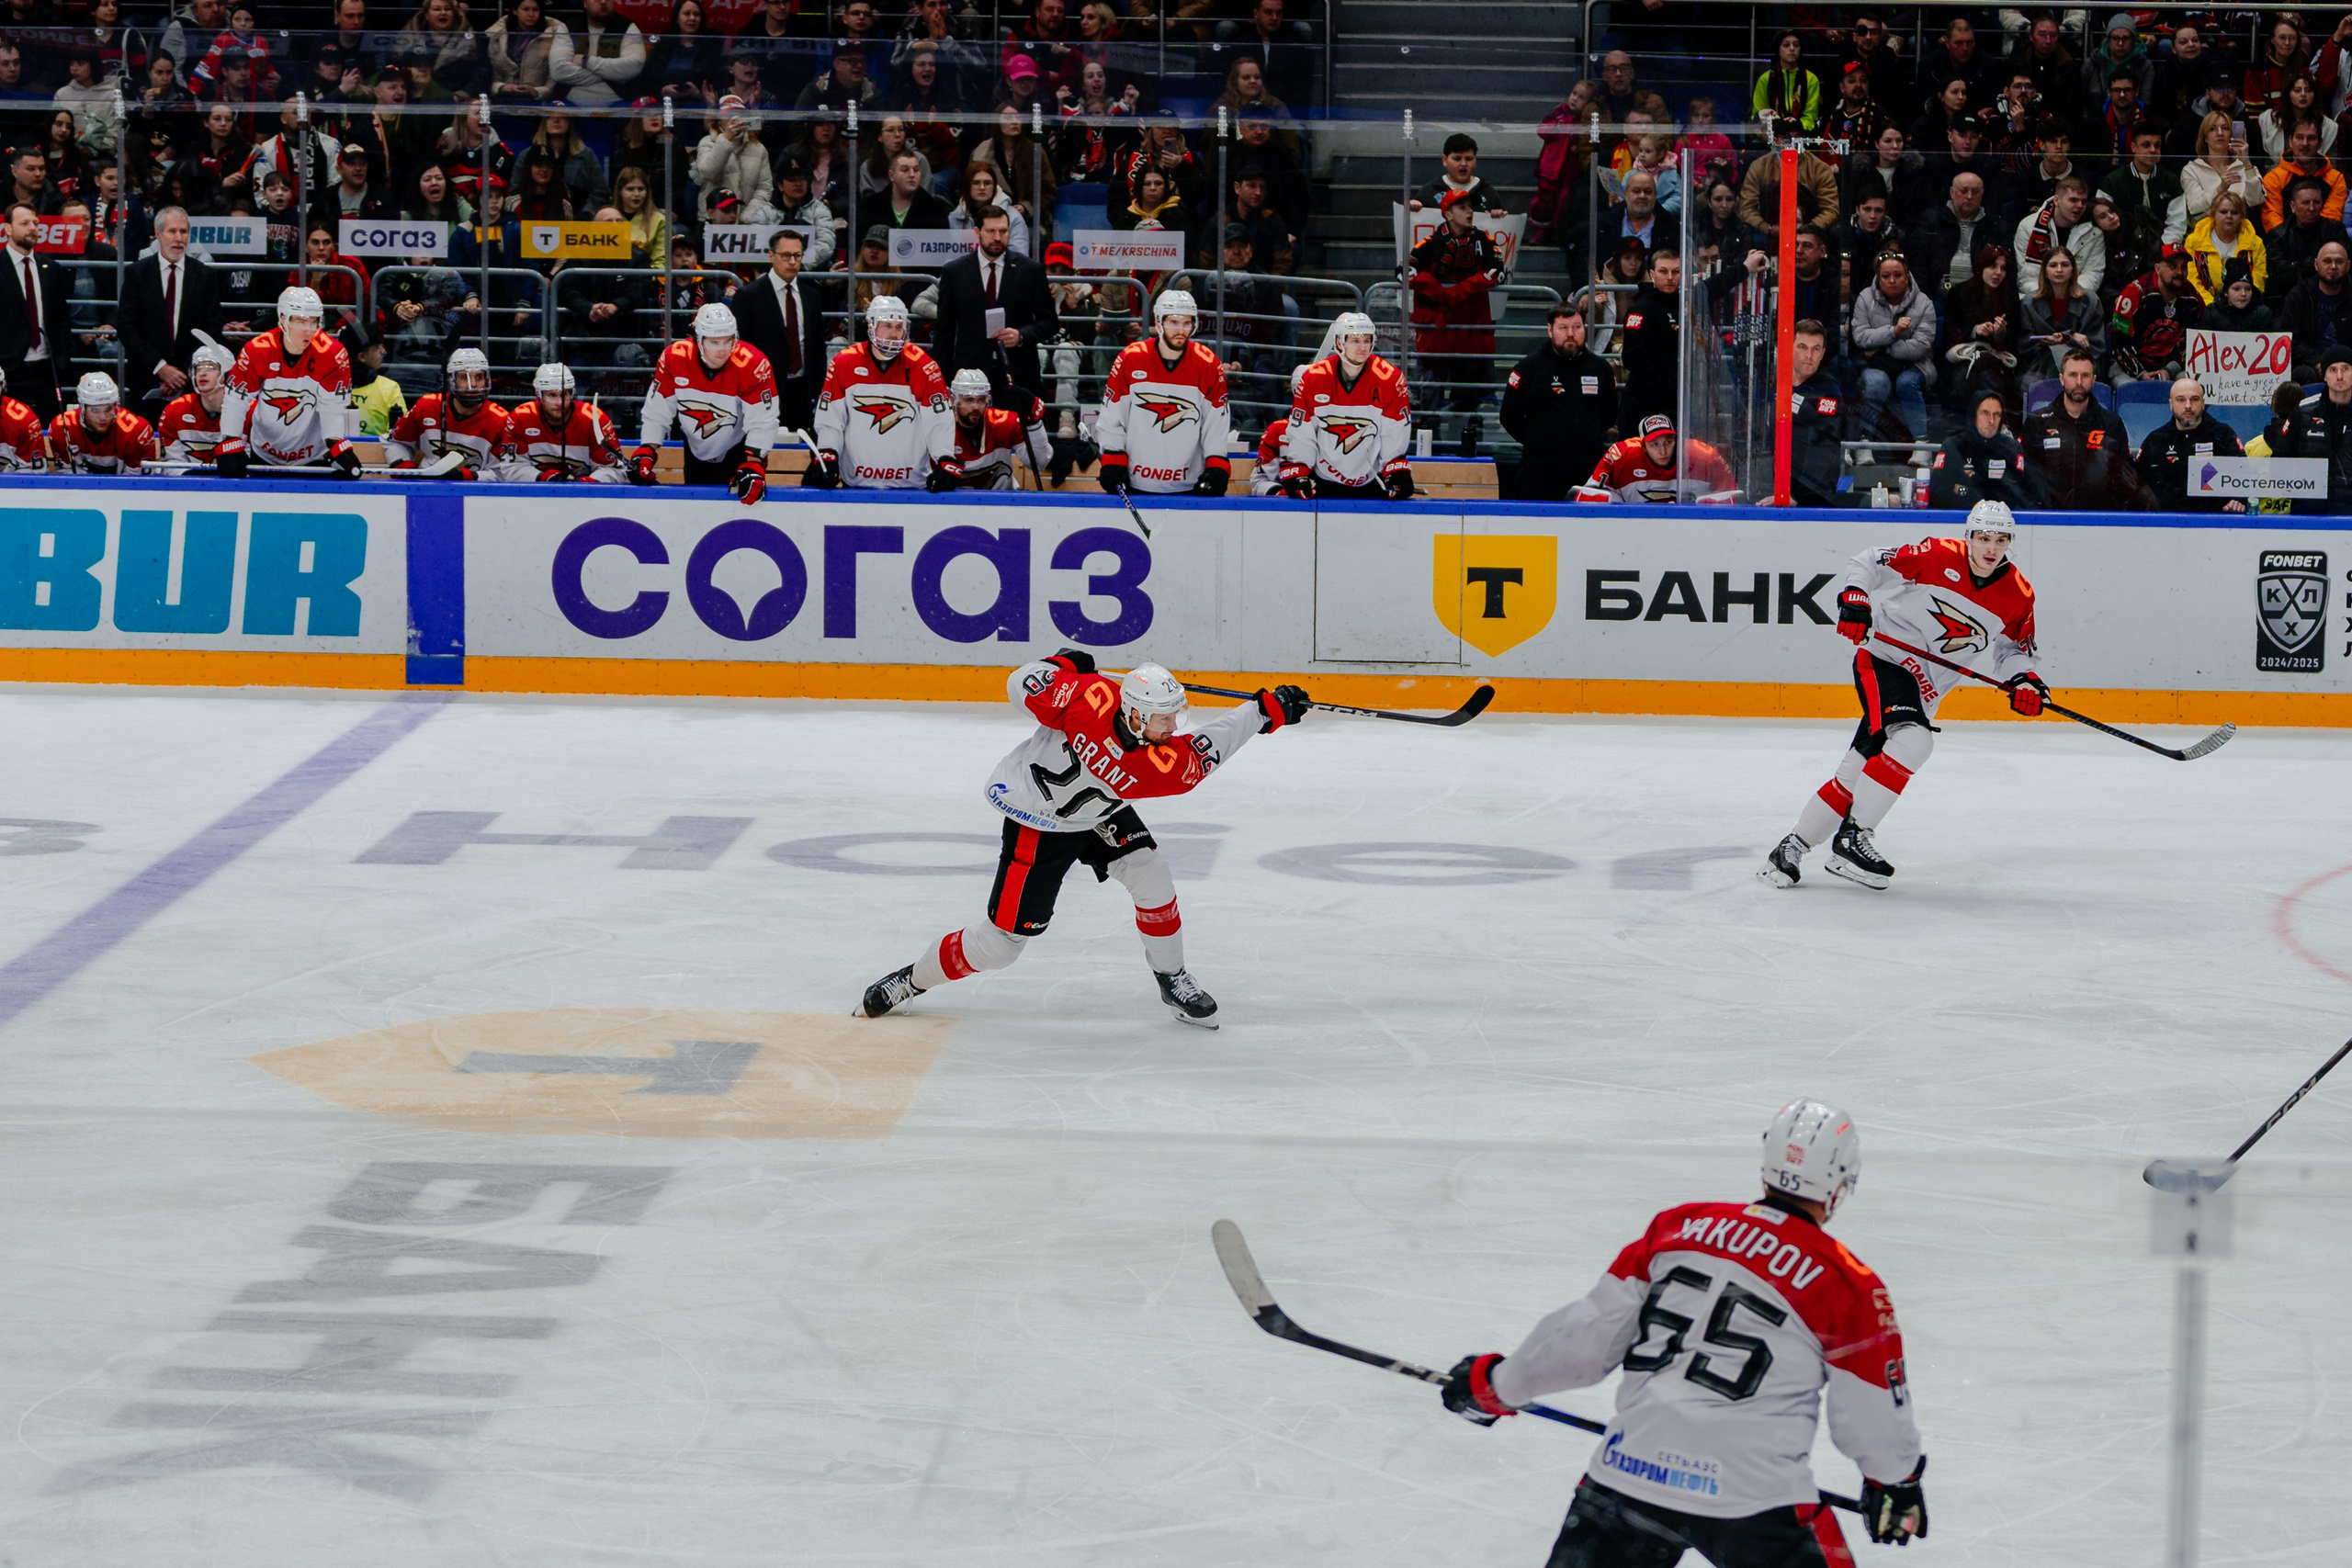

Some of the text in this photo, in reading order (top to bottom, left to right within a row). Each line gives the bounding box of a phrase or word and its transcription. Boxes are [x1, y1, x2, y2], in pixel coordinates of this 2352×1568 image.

[189, 226, 252, 244] IBUR
[565, 233, 620, 247] БАНК
[709, 232, 810, 254] KHL.
[1091, 245, 1178, 257] T.ME/KRSCHINA
[2219, 376, 2242, 390] have
[2254, 377, 2280, 391] great
[760, 389, 775, 411] 9
[1820, 399, 1837, 407] FON
[2217, 390, 2241, 403] have
[2243, 390, 2256, 403] to
[1818, 405, 1836, 413] BET
[1291, 408, 1306, 428] 9
[854, 466, 914, 480] FONBET
[1132, 464, 1189, 481] FONBET
[2220, 474, 2316, 491] Ростелеком
[2263, 554, 2324, 568] FONBET
[1585, 569, 1837, 626] БАНК
[2260, 657, 2320, 668] 2024/2025
[1161, 678, 1180, 694] 20
[1899, 656, 1939, 707] FONBE
[1310, 704, 1379, 718] CCM
[1072, 732, 1139, 794] GRANT
[1779, 1169, 1802, 1192] 65
[1671, 1216, 1826, 1291] YAKUPOV
[1623, 1265, 1789, 1401] 65
